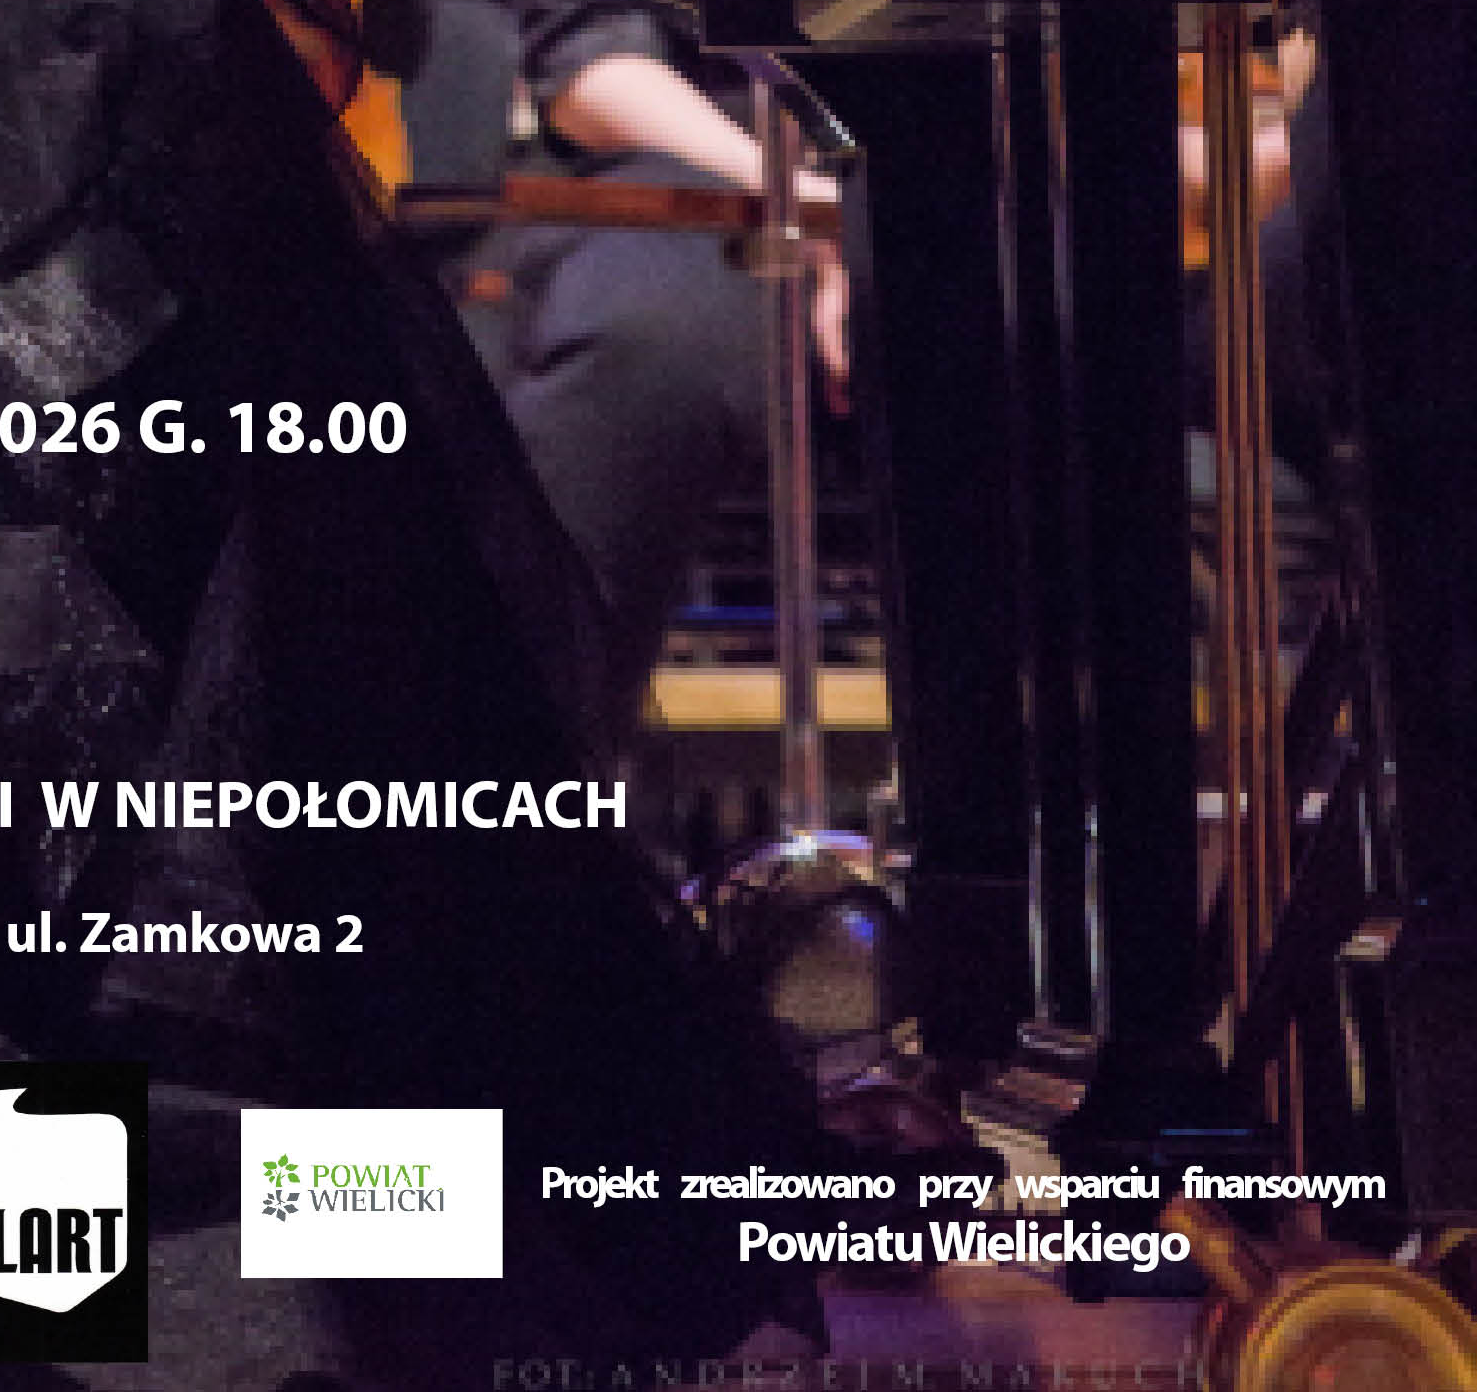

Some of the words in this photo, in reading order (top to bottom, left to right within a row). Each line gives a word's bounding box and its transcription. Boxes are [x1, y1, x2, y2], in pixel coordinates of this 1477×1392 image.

[139, 399, 206, 454] G.
[229, 401, 407, 454] 18.00
[41, 781, 99, 828] W
[117, 780, 626, 829] NIEPOŁOMICACH
[8, 910, 67, 953] ul.
[80, 910, 320, 953] Zamkowa
[336, 914, 363, 953] 2
[311, 1164, 431, 1188] POWIAT
[542, 1165, 659, 1208] Projekt
[680, 1165, 896, 1199] zrealizowano
[919, 1175, 993, 1208] przy
[1015, 1165, 1159, 1208] wsparciu
[1182, 1165, 1386, 1209] finansowym
[307, 1187, 444, 1212] WIELICKI
[740, 1221, 922, 1262] Powiatu
[929, 1219, 1190, 1273] Wielickiego
